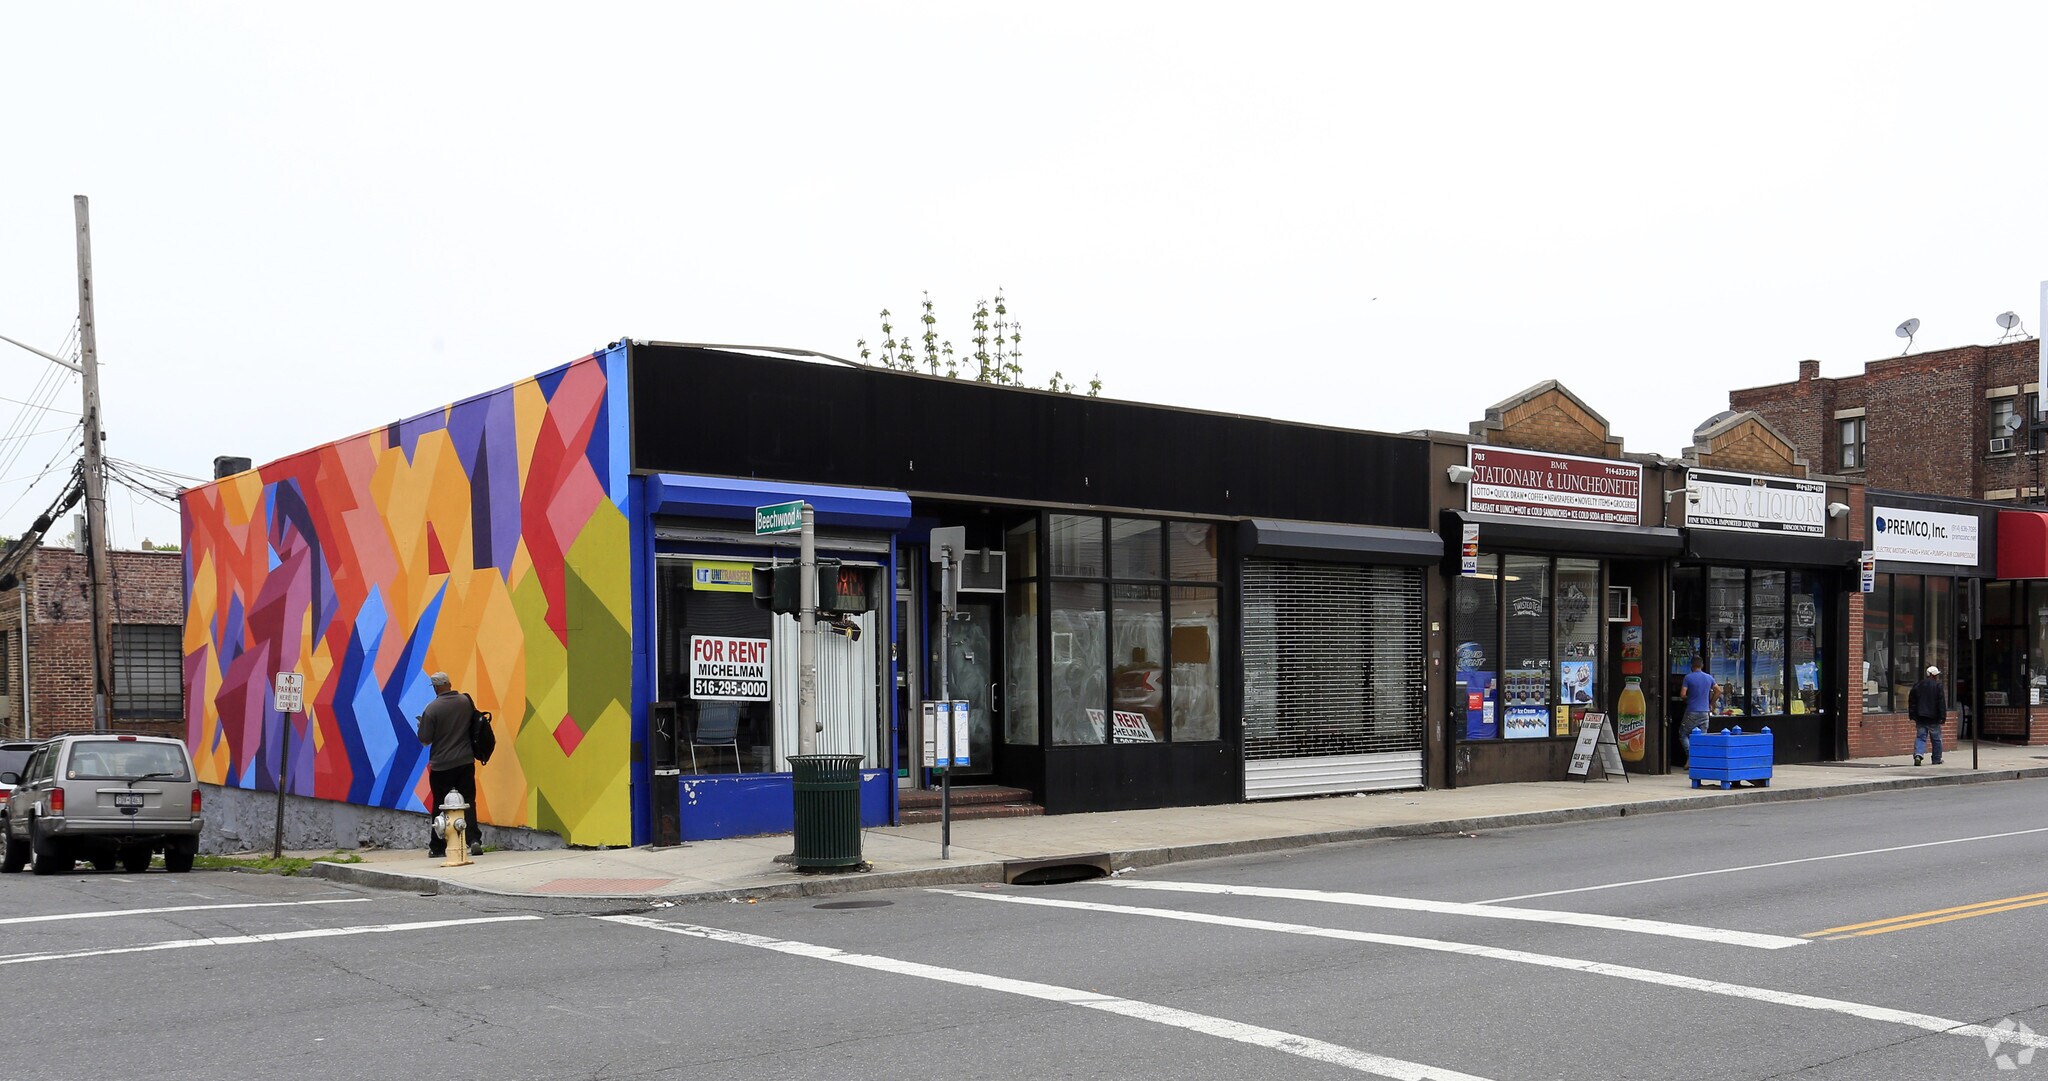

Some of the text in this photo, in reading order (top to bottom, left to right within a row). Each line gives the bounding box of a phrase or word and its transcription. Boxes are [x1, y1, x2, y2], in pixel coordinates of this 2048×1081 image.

[1474, 452, 1485, 461] 703
[1550, 460, 1568, 470] BMK
[1473, 464, 1639, 496] STATIONARY & LUNCHEONETTE
[1474, 487, 1636, 509] LOTTO QUICK DRAW COFFEE NEWSPAPERS NOVELTY ITEMS GROCERIES
[1690, 485, 1822, 523] INES & LIQUORS
[757, 506, 796, 530] Beechwood
[1472, 501, 1495, 512] BREAKFAST
[1500, 504, 1515, 514] LUNCH
[1517, 506, 1527, 515] HOT
[1531, 507, 1543, 516] COLD
[1543, 508, 1568, 518] SANDWICHES
[1578, 510, 1589, 519] COLD
[1589, 512, 1601, 520] SODA
[1604, 513, 1614, 521] BEER
[1616, 514, 1637, 523] CIGARETTES
[1688, 516, 1700, 524] FINE
[1700, 517, 1715, 525] WINES
[1718, 518, 1742, 527] IMPORTED
[1742, 520, 1760, 528] LIQUOR
[1782, 523, 1823, 533] DISCOUNT PRICES
[1887, 518, 1948, 540] PREMCO, Inc.
[711, 568, 751, 582] UNITRANSFER
[837, 596, 865, 609] ALK
[1513, 601, 1532, 610] TWISTED
[694, 639, 768, 663] FOR RENT
[1462, 651, 1483, 659] BUD
[1458, 658, 1486, 667] LIGHT
[698, 663, 763, 678] MICHELMAN
[284, 676, 295, 684] NO
[278, 685, 301, 695] PARKING
[695, 680, 766, 696] 516-295-9000
[1114, 712, 1146, 729] RENT
